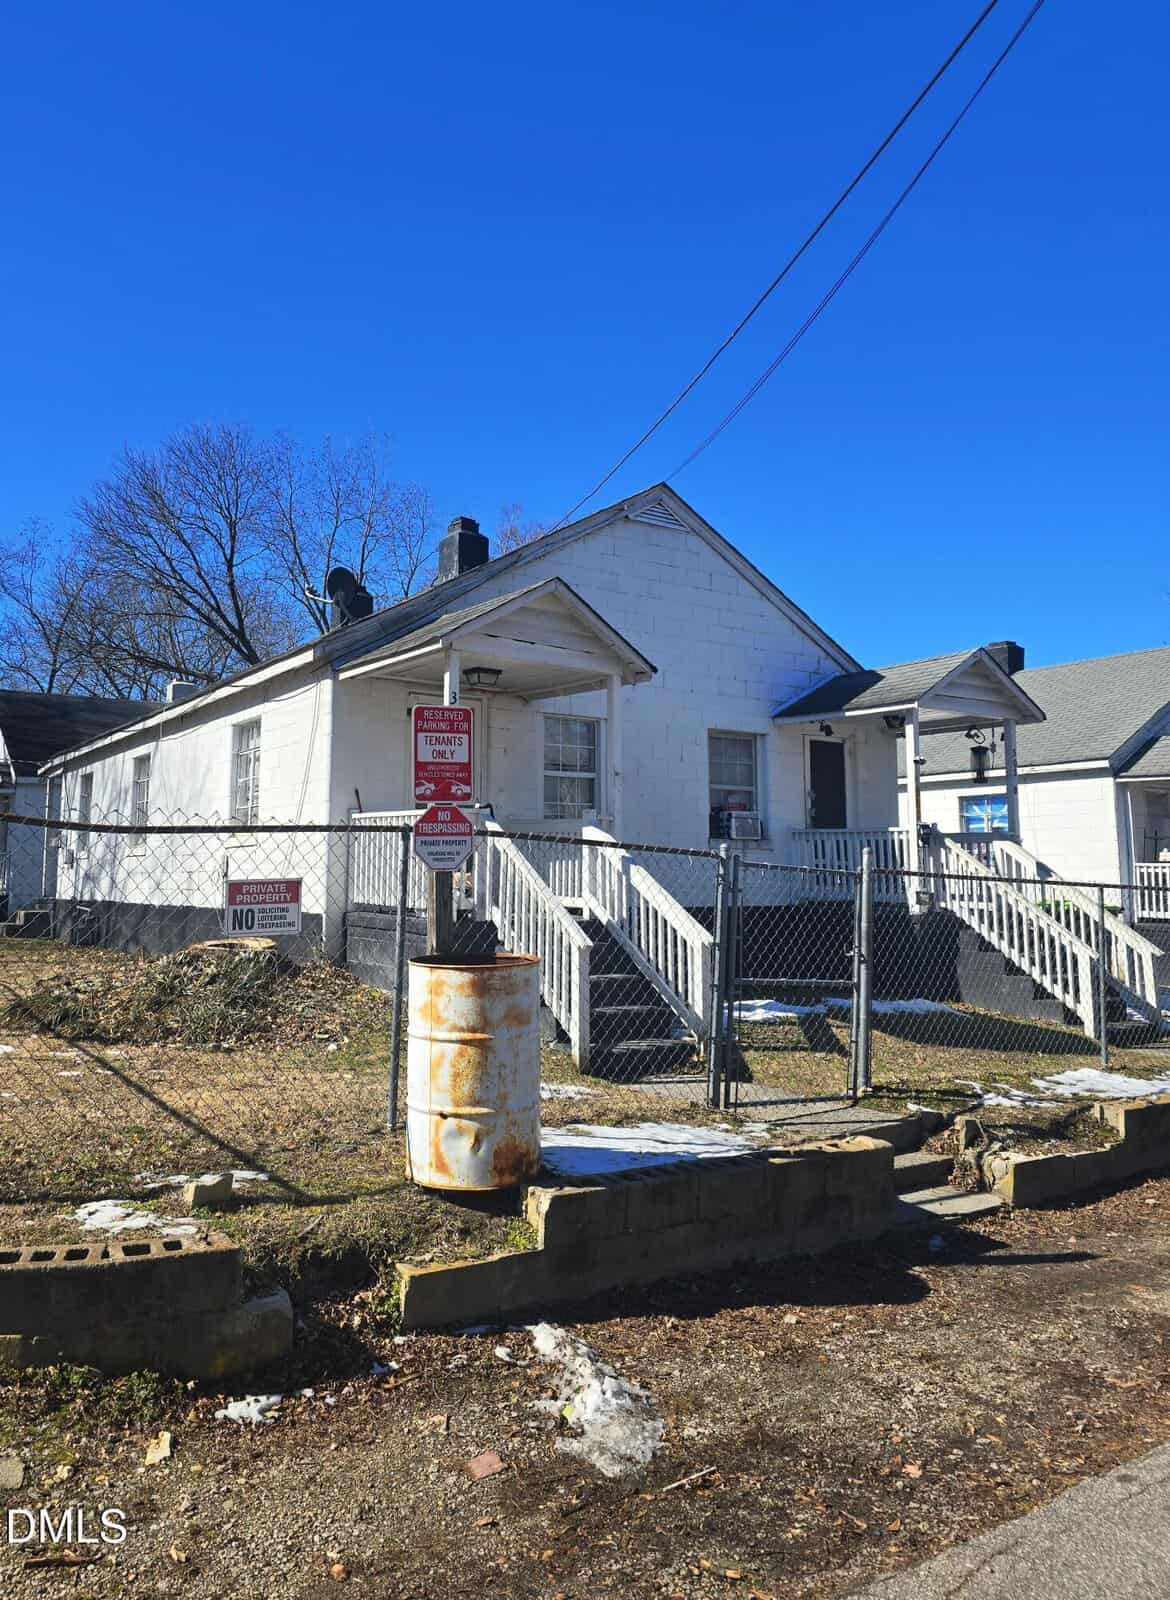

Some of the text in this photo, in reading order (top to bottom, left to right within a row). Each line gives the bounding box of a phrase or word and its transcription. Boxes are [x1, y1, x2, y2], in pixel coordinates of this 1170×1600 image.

[450, 691, 457, 704] 3
[424, 710, 464, 721] RESERVED
[418, 720, 469, 732] PARKING FOR
[424, 735, 463, 746] TENANTS
[432, 749, 455, 760] ONLY
[437, 810, 451, 821] NO
[418, 823, 470, 833] TRESPASSING
[420, 839, 467, 847] PRIVATE PROPERTY
[243, 883, 287, 894] PRIVATE
[236, 892, 292, 904] PROPERTY
[232, 908, 256, 931] NO
[257, 921, 296, 929] TRESPASSING
